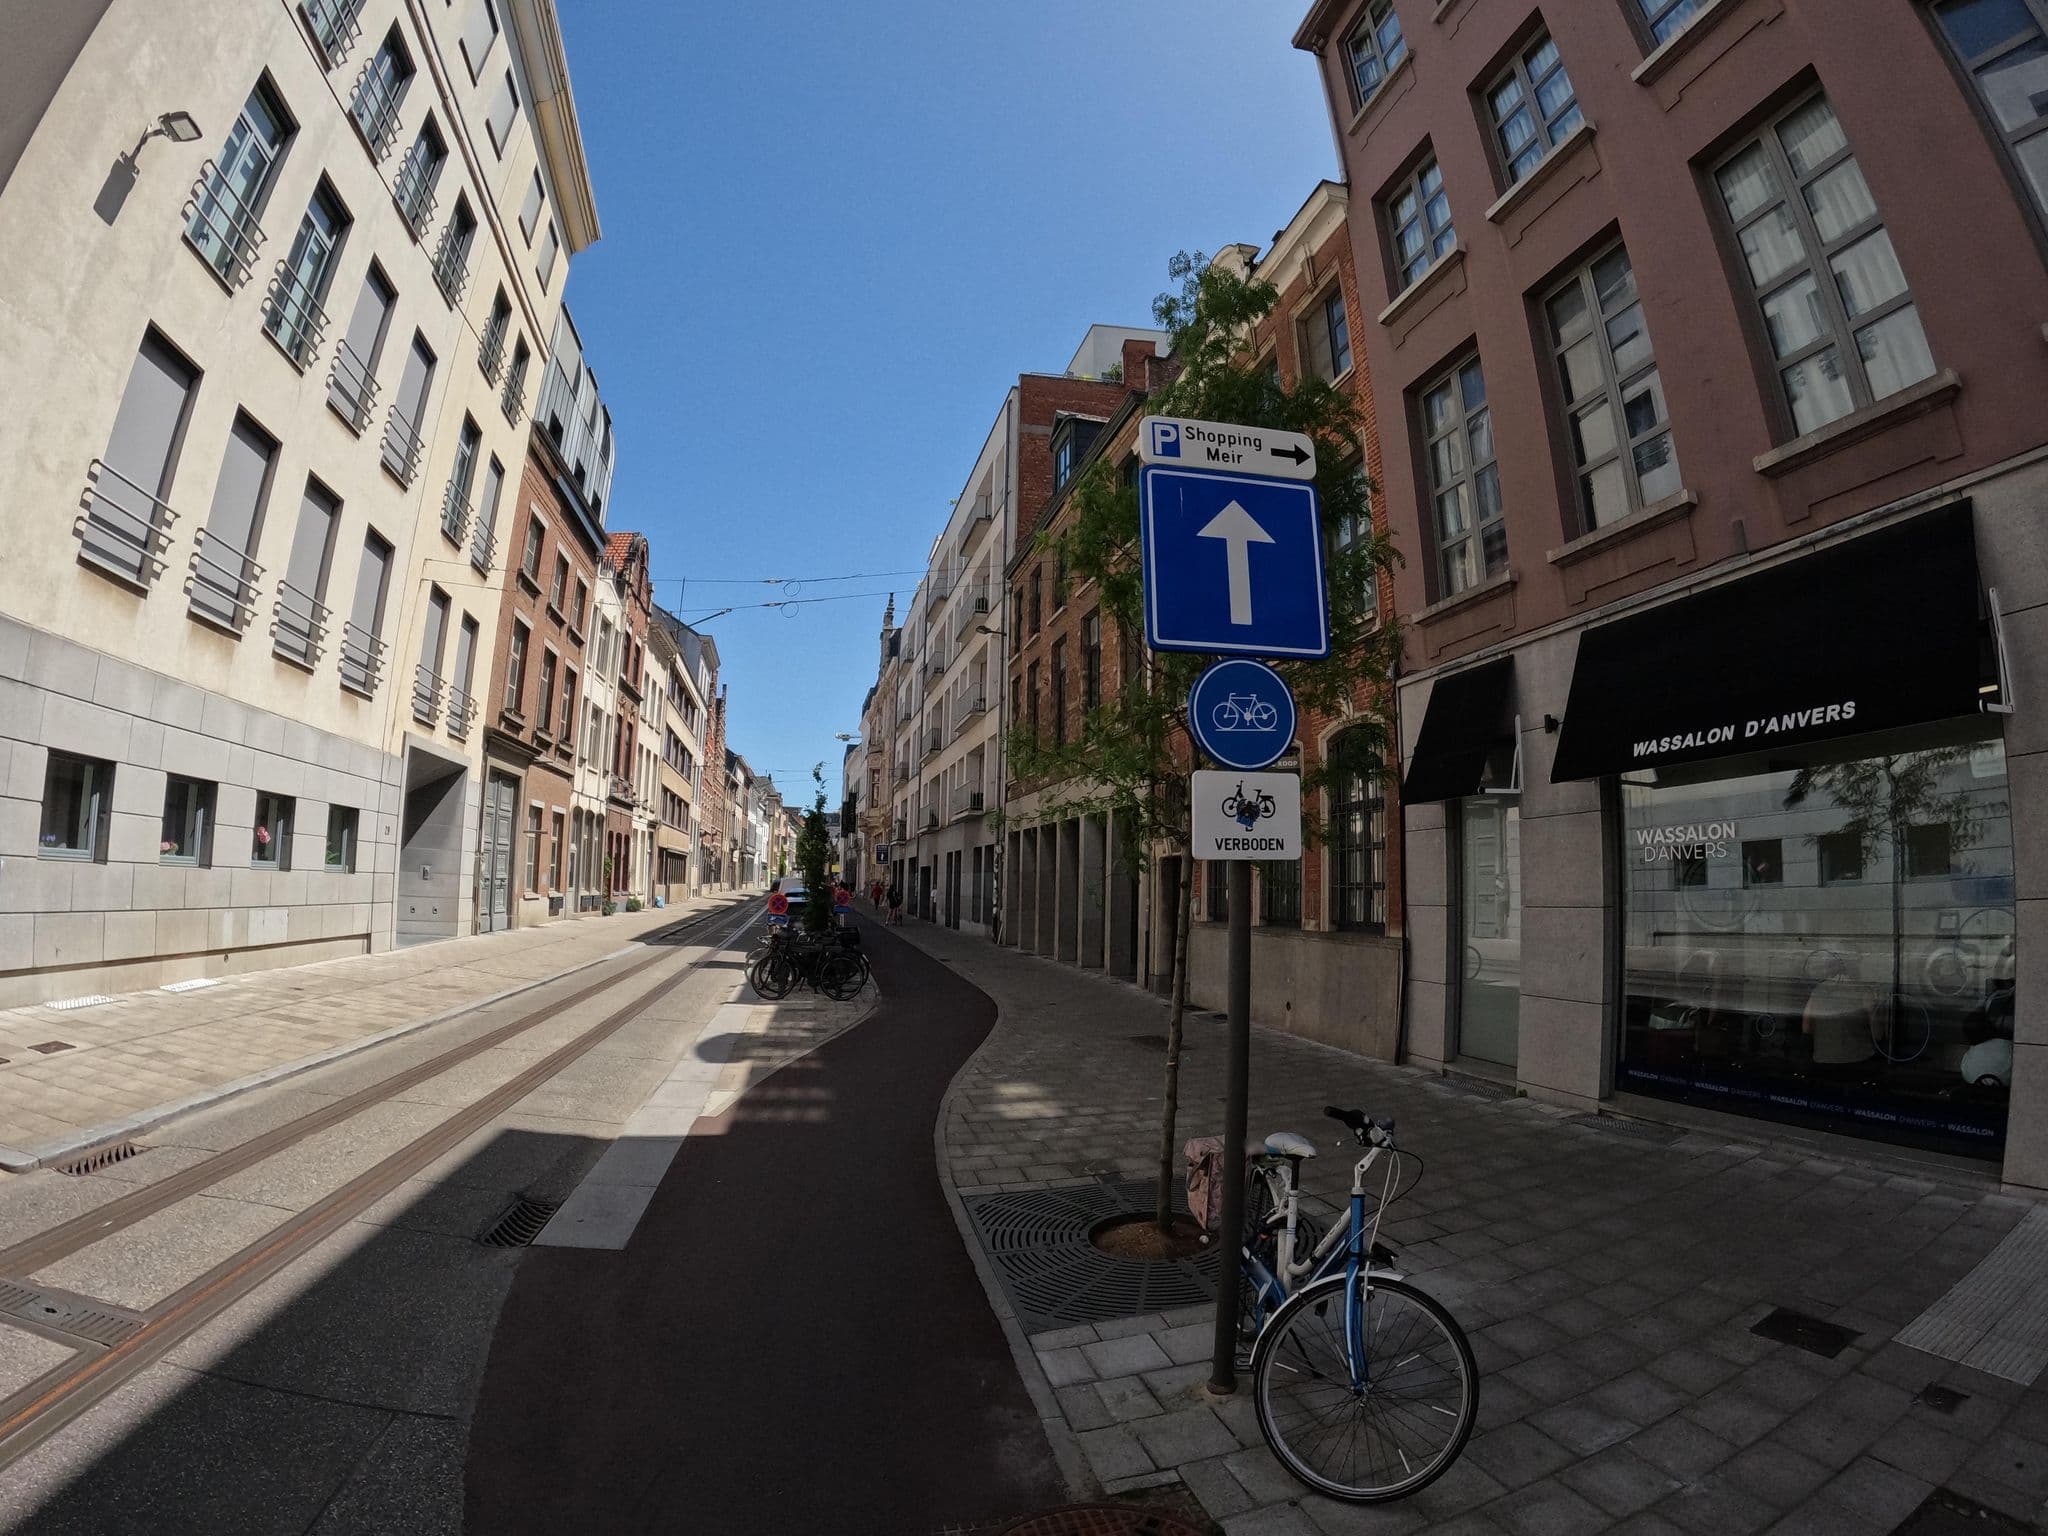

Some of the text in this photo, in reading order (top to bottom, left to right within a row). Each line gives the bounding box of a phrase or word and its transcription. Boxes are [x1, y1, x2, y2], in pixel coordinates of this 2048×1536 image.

[1153, 423, 1262, 455] P Shopping
[1207, 447, 1243, 464] Meir
[1633, 701, 1856, 757] WASSALON D'ANVERS
[1215, 838, 1284, 851] VERBODEN
[1636, 822, 1736, 845] WASSALON
[1695, 1081, 1729, 1093] WASSALON
[1768, 1094, 1808, 1107] WASSALON
[1855, 1109, 1896, 1121] WASSALON
[1947, 1123, 1996, 1138] WASSALON
